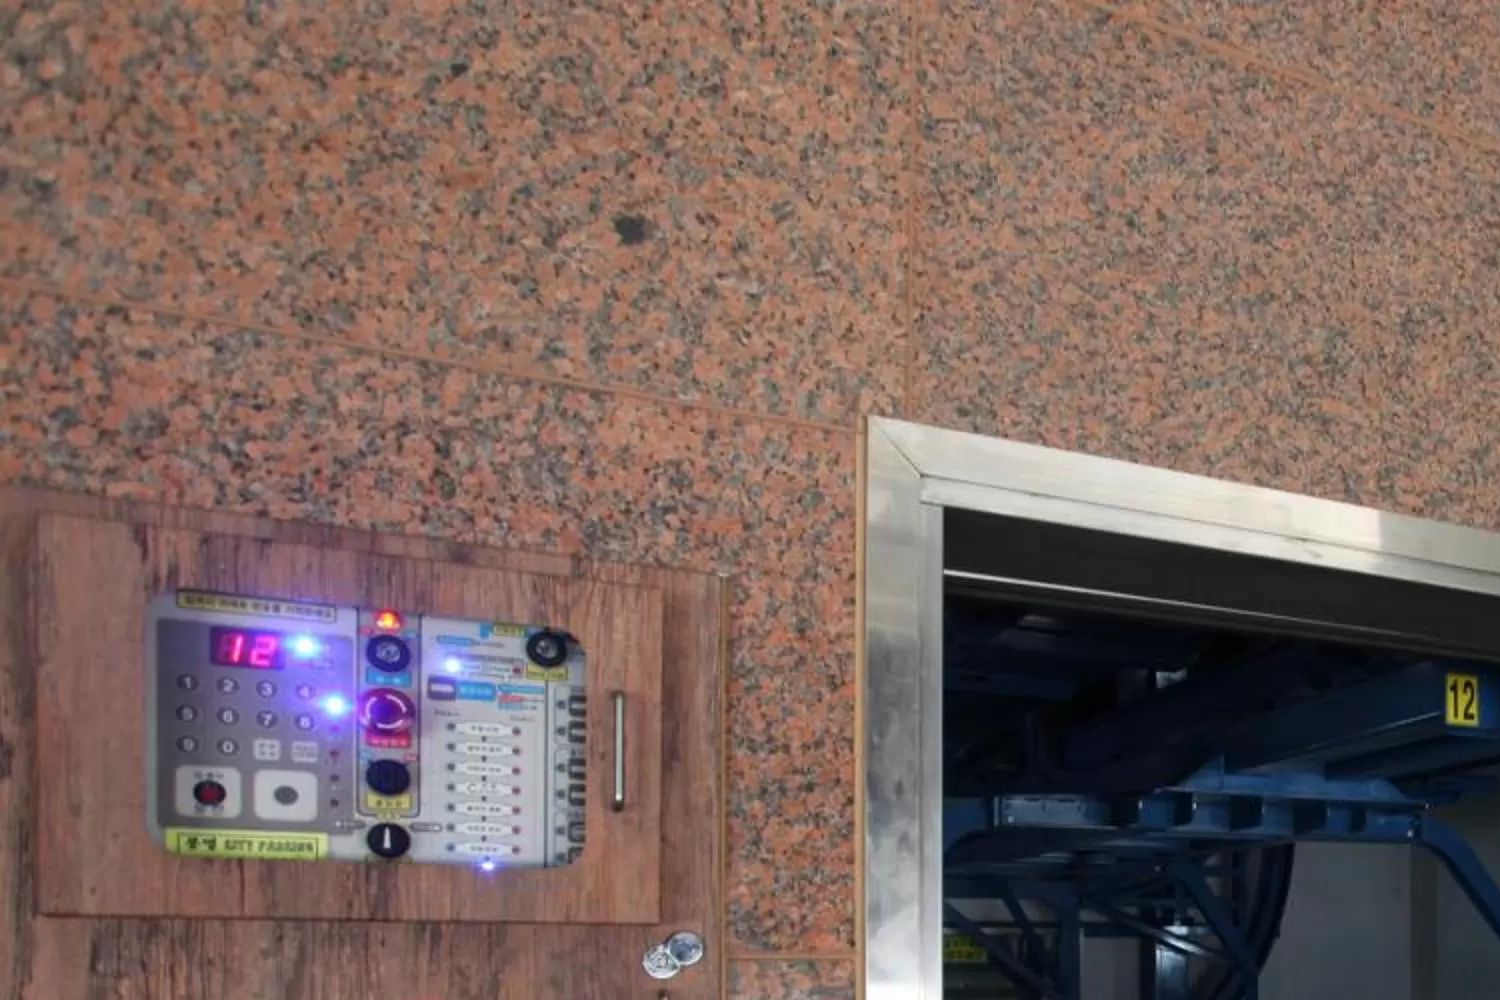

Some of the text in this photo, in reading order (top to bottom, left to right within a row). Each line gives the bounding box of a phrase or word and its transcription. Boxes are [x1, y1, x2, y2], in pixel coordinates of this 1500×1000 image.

[229, 632, 278, 667] 12
[223, 679, 234, 692] 2
[262, 683, 273, 696] 3
[1450, 679, 1475, 721] 12
[262, 713, 274, 728] 7
[222, 740, 234, 753] 0
